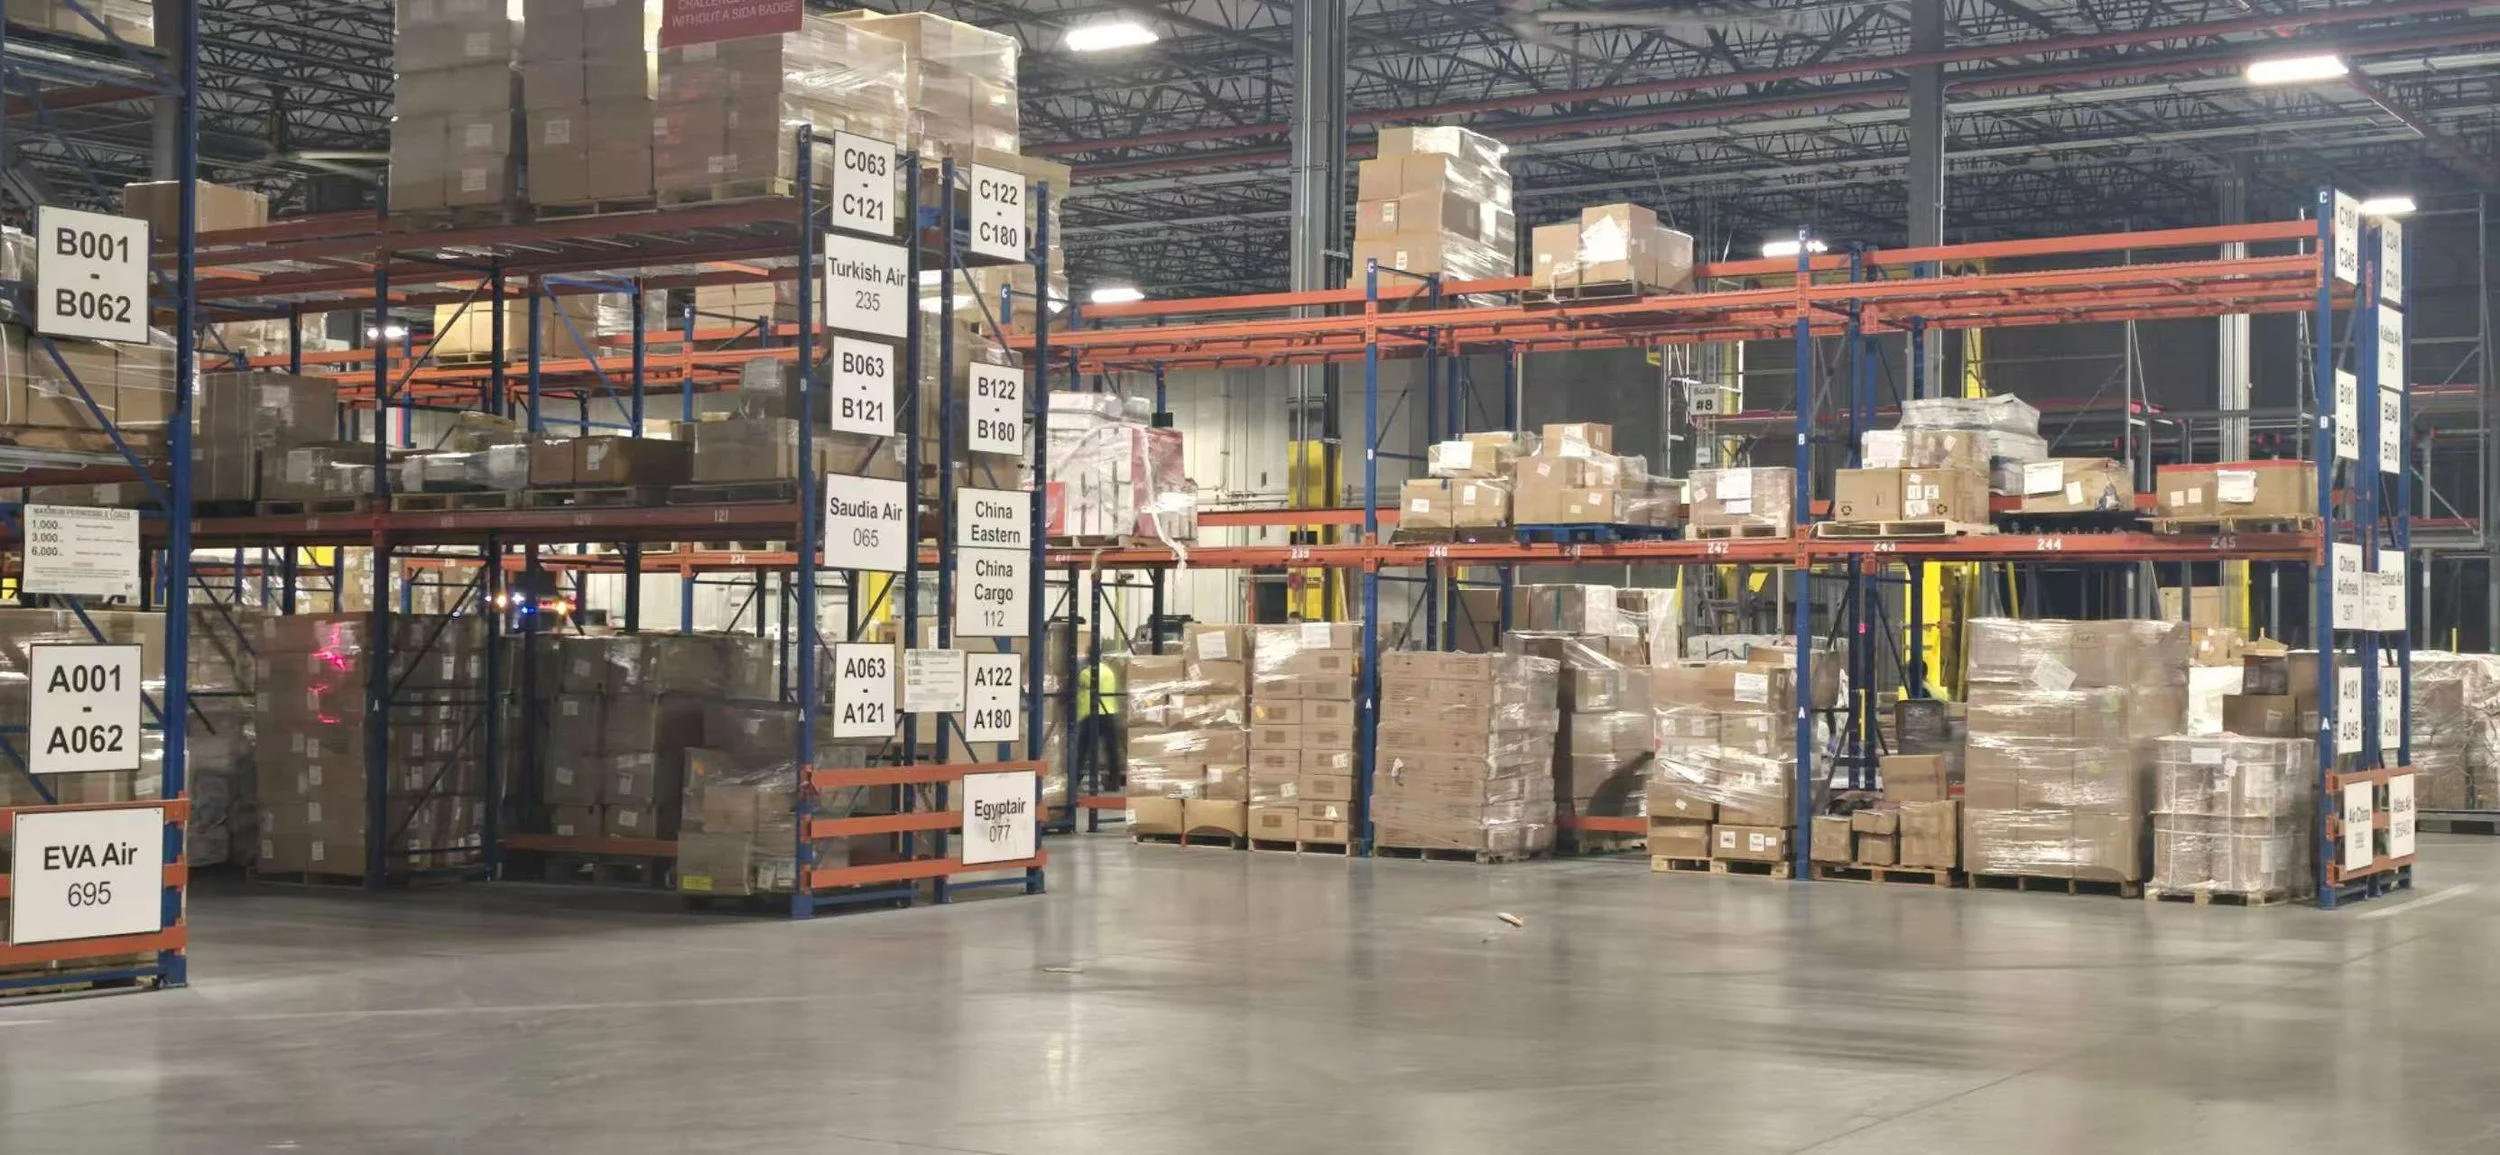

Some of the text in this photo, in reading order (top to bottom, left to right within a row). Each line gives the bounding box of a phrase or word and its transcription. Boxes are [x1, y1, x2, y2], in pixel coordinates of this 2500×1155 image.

[672, 1, 796, 28] WITHOUT A SIDA BADGE
[844, 148, 887, 176] C063
[979, 179, 1018, 205] C122
[2319, 191, 2327, 204] C
[843, 194, 883, 221] C121
[980, 222, 1017, 247] C180
[1799, 229, 1806, 240] C
[57, 228, 130, 264] B001
[828, 257, 905, 287] Turkish Air
[1368, 262, 1374, 273] C
[856, 290, 881, 311] 235
[1001, 287, 1007, 298] C
[56, 289, 131, 323] B062
[684, 308, 690, 318] C
[843, 352, 884, 378] B063
[978, 377, 1016, 400] B122
[842, 398, 884, 422] B121
[1696, 400, 1713, 410] #8
[977, 419, 1015, 442] B180
[1798, 433, 1805, 445] B
[830, 497, 903, 521] Saudia Air
[975, 500, 1013, 519] China
[32, 532, 58, 543] 3,000
[853, 528, 879, 547] 065
[971, 525, 1021, 544] Eastern
[2037, 538, 2062, 549] 244
[2211, 536, 2237, 548] 245
[31, 546, 58, 557] 6,000
[1708, 542, 1728, 553] 242
[975, 559, 1013, 578] China
[974, 583, 1014, 605] Cargo
[983, 610, 1005, 627] 112
[845, 657, 886, 679] A063
[975, 667, 1013, 686] A122
[48, 664, 122, 693] A001
[1365, 698, 1372, 709] A
[1798, 706, 1805, 719] A
[798, 708, 805, 722] A
[843, 703, 885, 724] A121
[974, 709, 1012, 729] A180
[2321, 717, 2330, 731] A
[46, 725, 124, 755] A062
[974, 799, 1026, 821] Egyptair
[989, 824, 1011, 843] 077
[43, 842, 138, 872] EVA Air
[67, 881, 112, 907] 695
